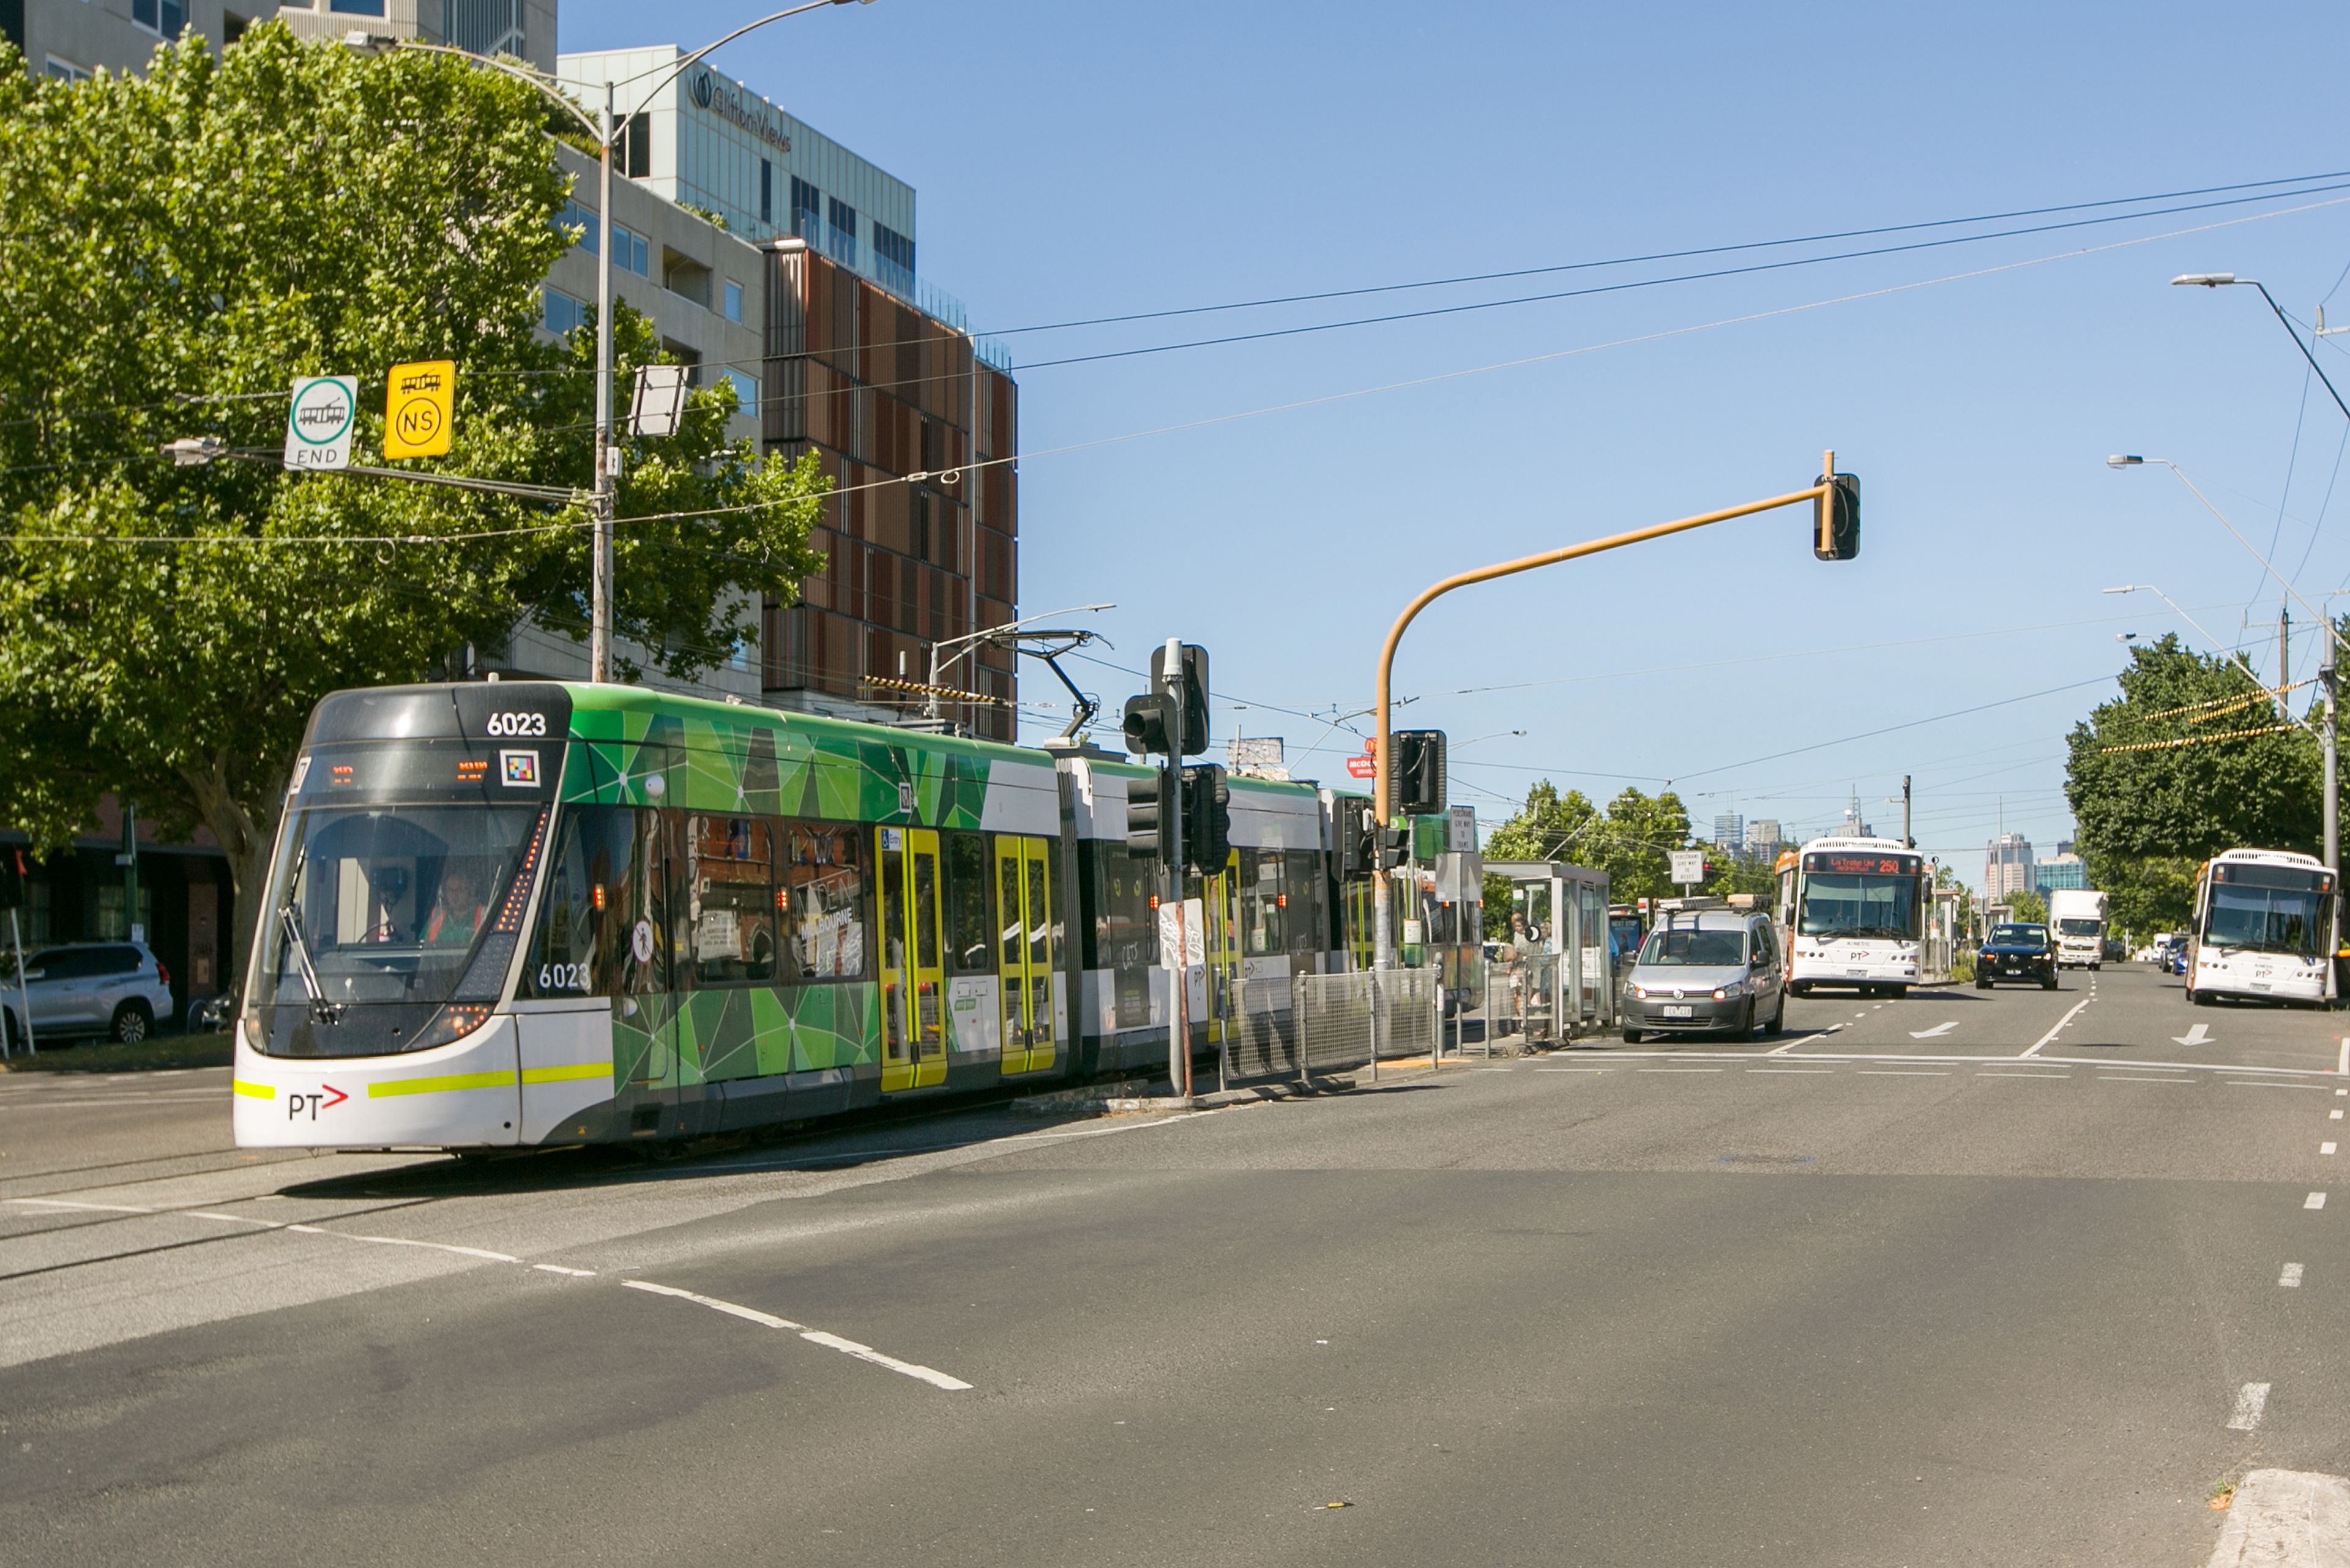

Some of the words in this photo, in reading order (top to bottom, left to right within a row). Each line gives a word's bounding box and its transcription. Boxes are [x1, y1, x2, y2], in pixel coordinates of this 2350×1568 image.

[713, 86, 752, 132] Clifton
[756, 110, 791, 152] Views
[404, 411, 432, 432] NS
[297, 449, 337, 463] END
[488, 712, 546, 736] 6023
[1879, 859, 1900, 873] 250
[801, 907, 853, 940] MELBOURNE
[539, 963, 590, 988] 6023
